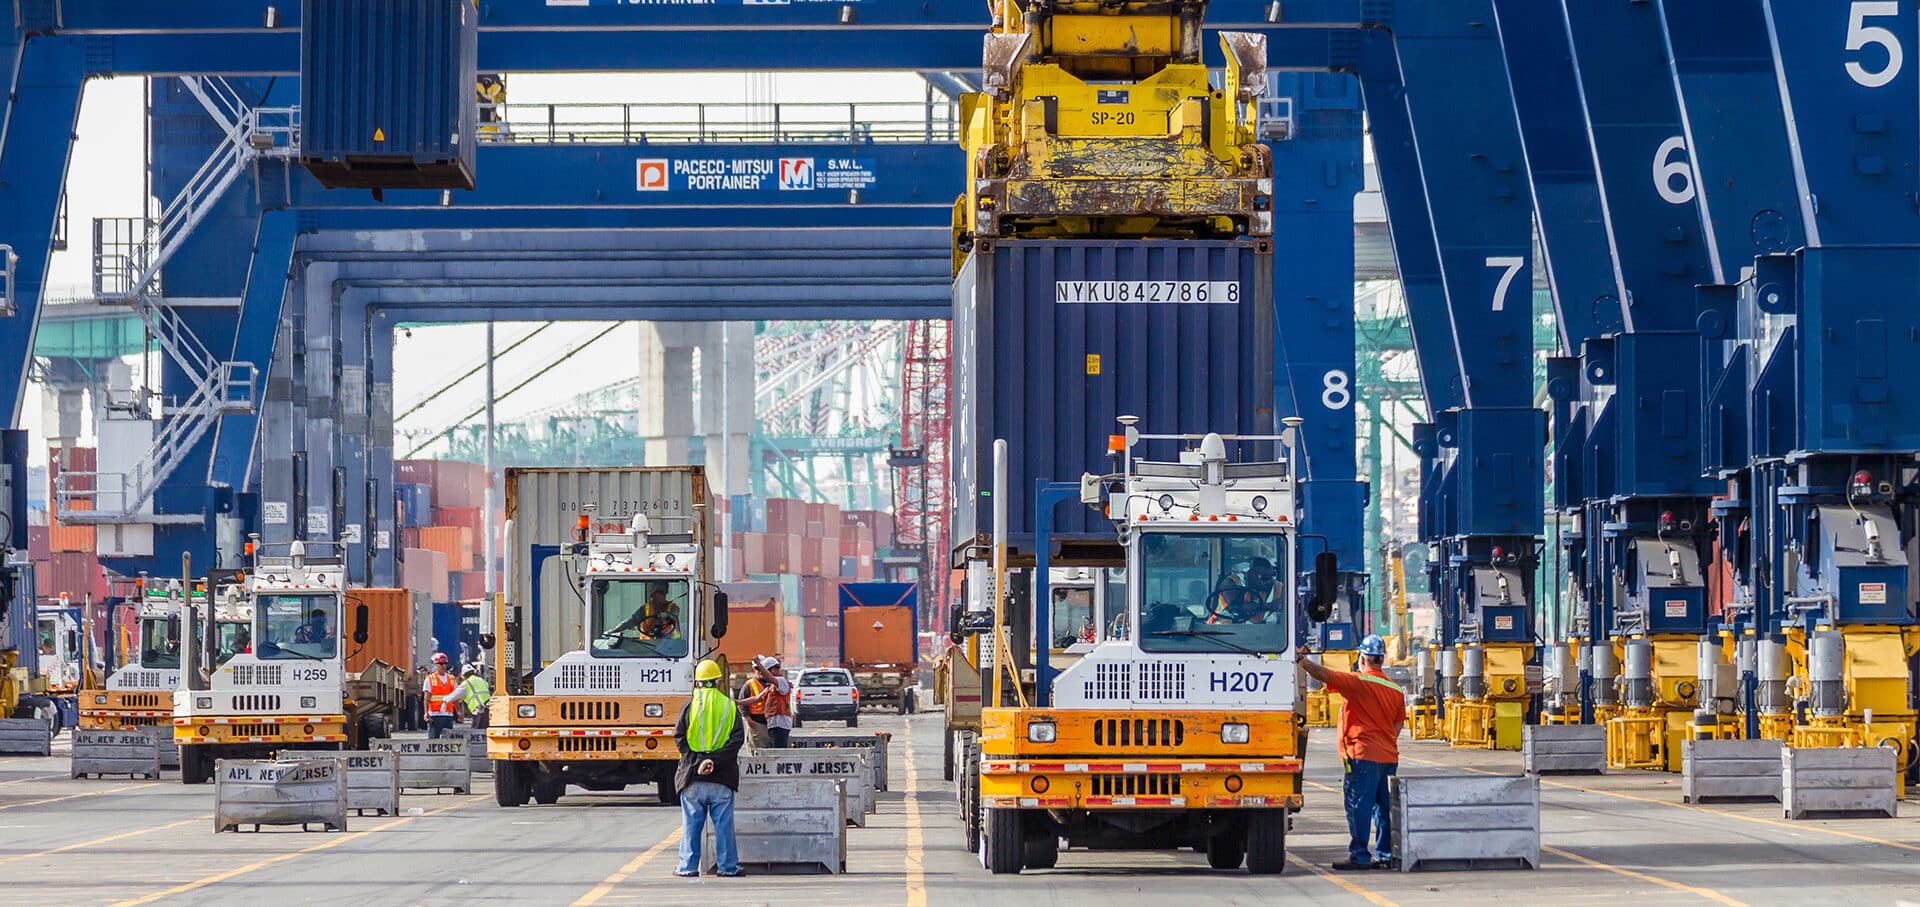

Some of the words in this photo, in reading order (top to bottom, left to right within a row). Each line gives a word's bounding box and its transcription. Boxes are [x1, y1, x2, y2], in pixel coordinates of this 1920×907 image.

[1845, 1, 1903, 88] 5
[1091, 111, 1135, 125] SP-20
[674, 159, 773, 174] PACECO-MITSUI
[828, 159, 863, 170] S.W.L.
[1653, 136, 1696, 204] 6
[688, 175, 760, 190] PORTAINER
[1485, 257, 1524, 311] 7
[1057, 283, 1208, 301] NYKU842786
[1227, 283, 1238, 301] 8
[1321, 369, 1350, 409] 8
[640, 668, 672, 683] H211
[1209, 671, 1274, 692] H207
[76, 735, 94, 744] APL
[97, 735, 115, 744] NEW
[119, 735, 151, 745] JERSEY
[400, 743, 420, 753] NEW
[425, 743, 462, 753] JERSEY
[347, 756, 384, 768] ERSEY
[745, 763, 770, 775] APL
[776, 762, 803, 774] NEW
[809, 761, 856, 775] JERSEY
[228, 768, 253, 781] APL
